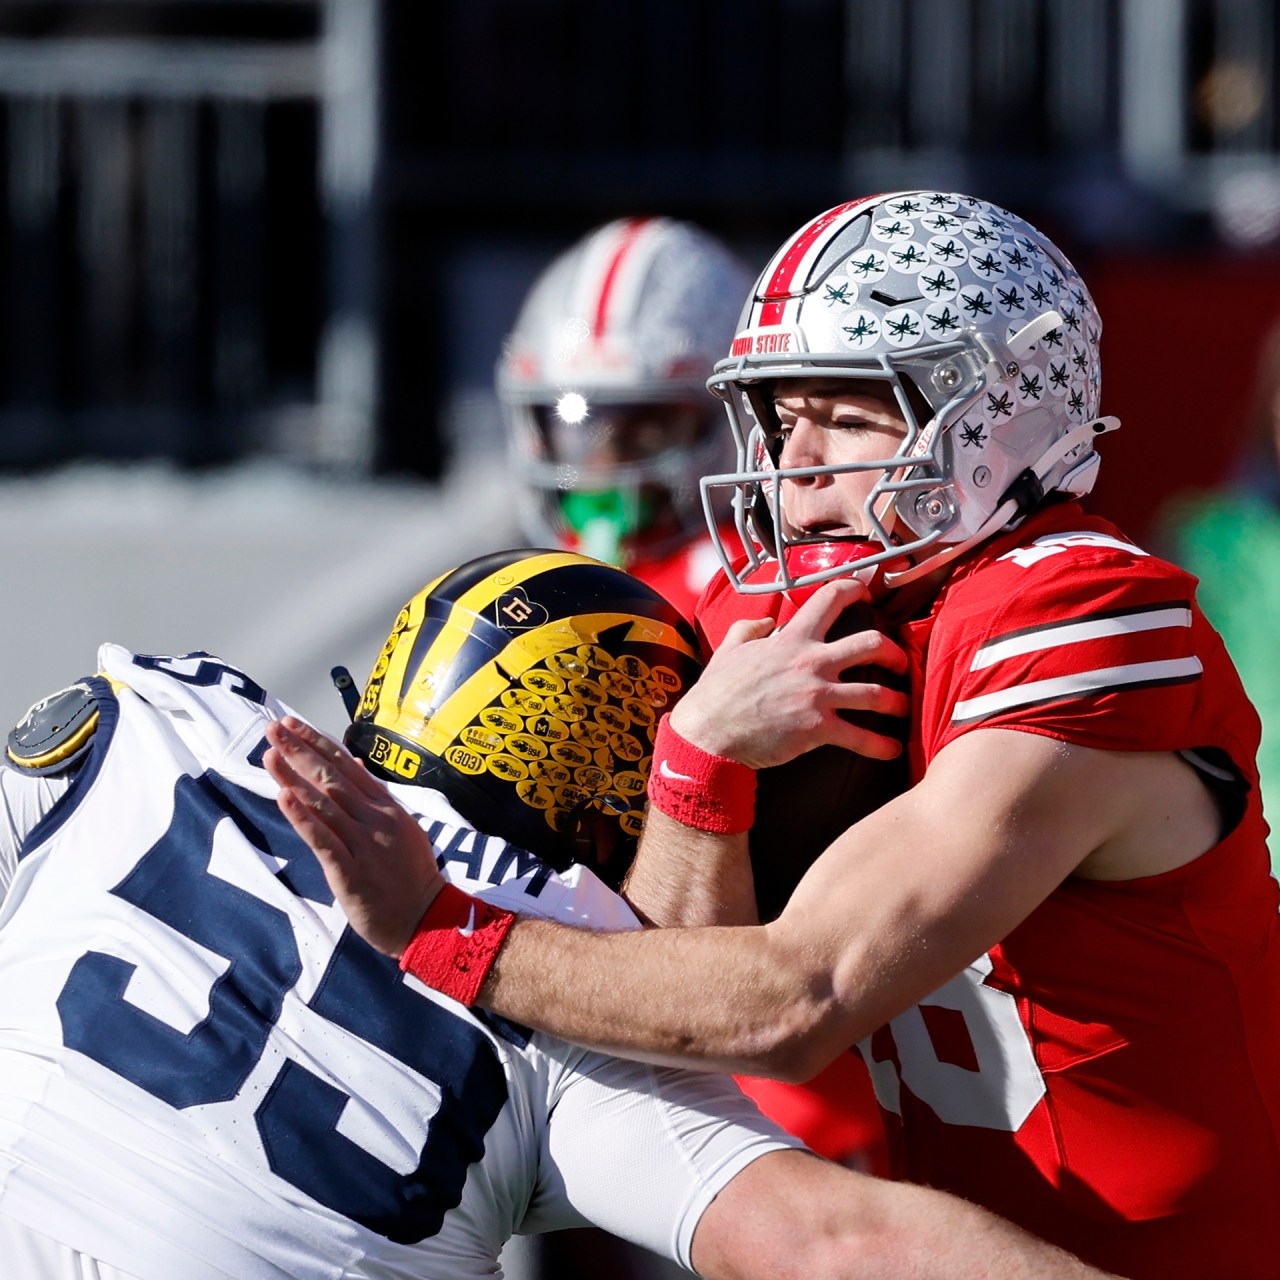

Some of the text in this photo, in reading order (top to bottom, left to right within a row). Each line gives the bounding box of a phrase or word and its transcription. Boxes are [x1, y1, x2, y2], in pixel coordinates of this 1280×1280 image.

[756, 333, 791, 352] STATE
[501, 596, 533, 623] G
[465, 736, 497, 751] EQUALITY
[450, 748, 482, 772] (303)
[625, 814, 643, 830] TE
[56, 769, 532, 1246] 55
